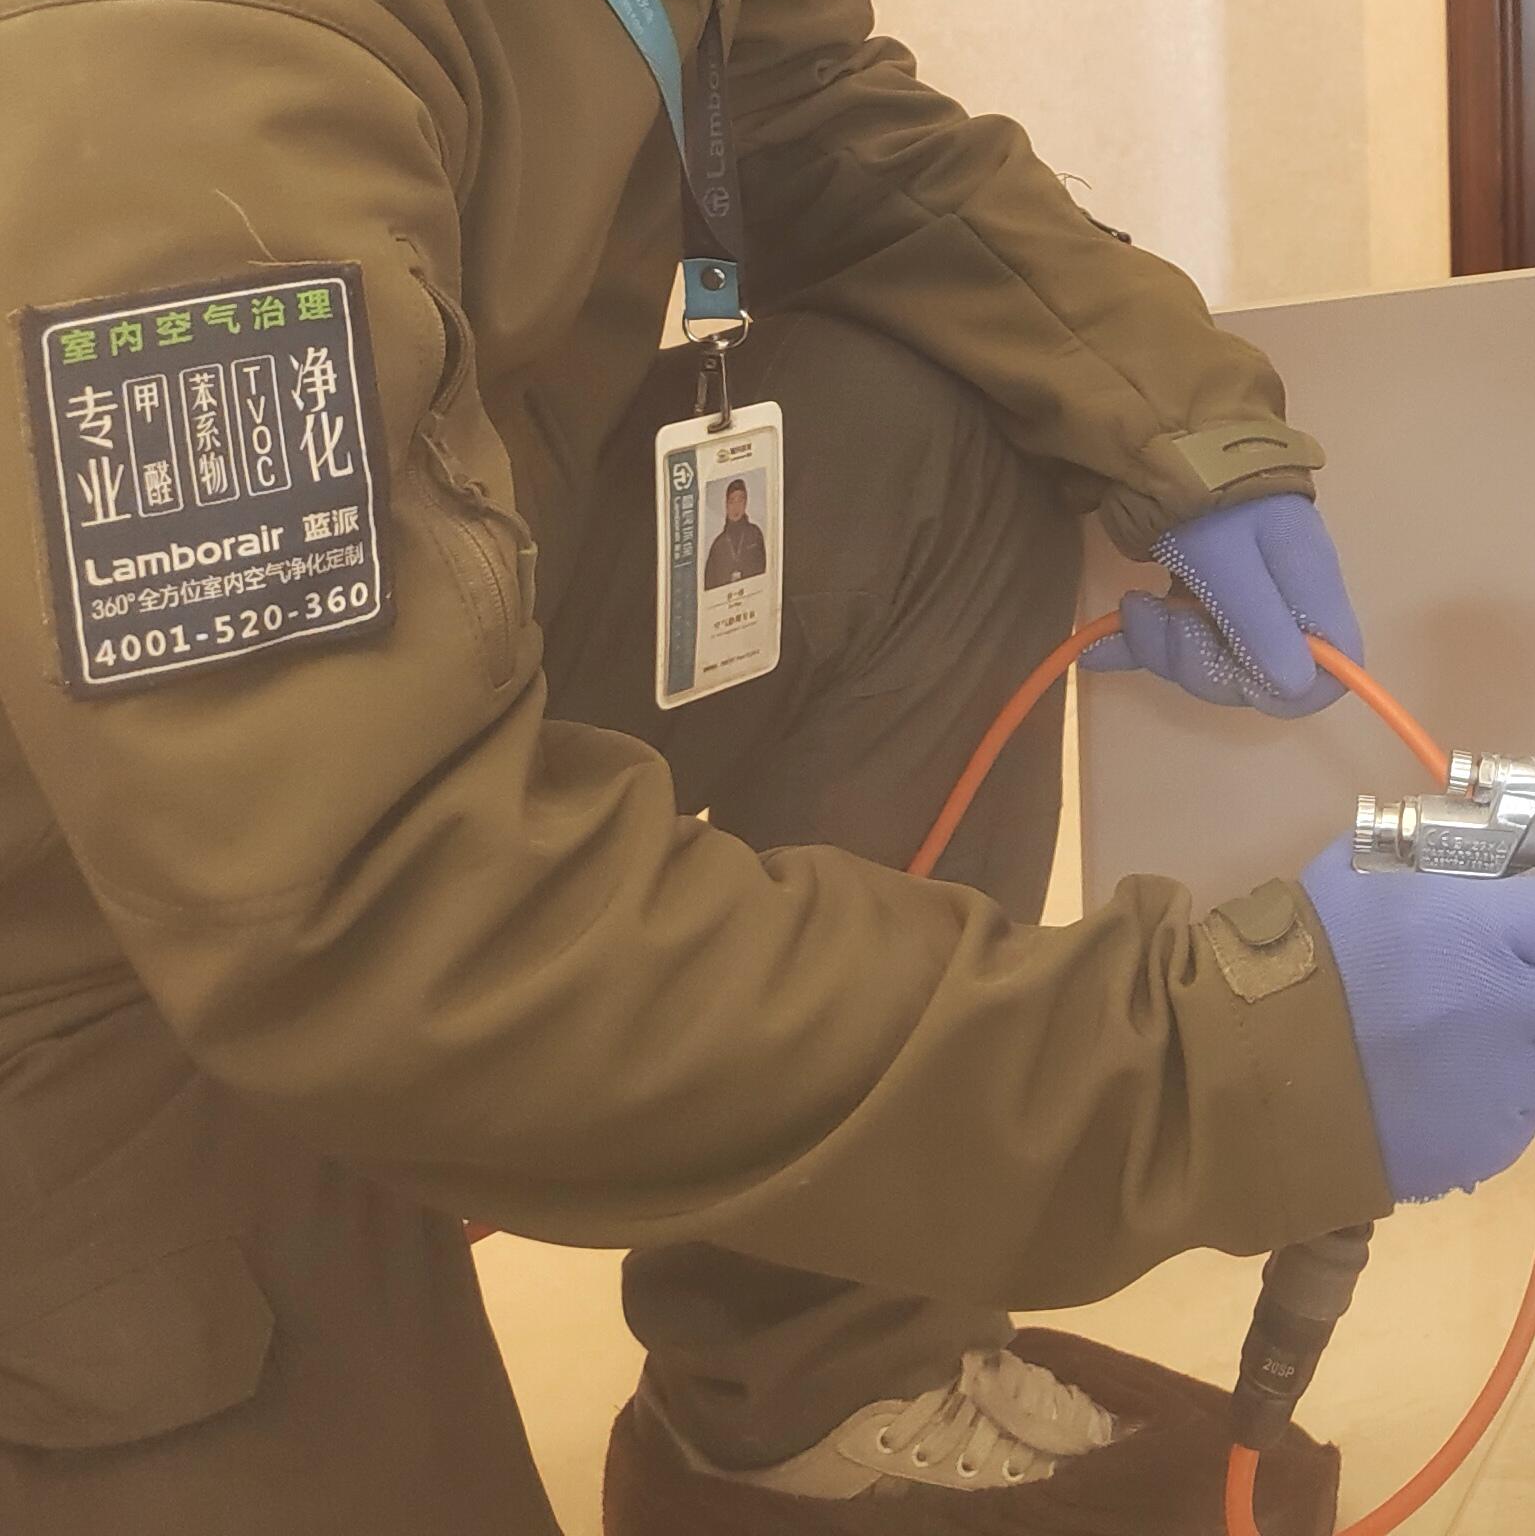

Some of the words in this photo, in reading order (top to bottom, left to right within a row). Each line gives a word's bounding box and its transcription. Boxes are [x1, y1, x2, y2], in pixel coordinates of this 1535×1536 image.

[60, 288, 333, 365] 室内空气治理
[66, 386, 131, 527] 专业
[134, 382, 174, 506] 甲醛
[189, 372, 228, 495] 苯系物
[243, 366, 275, 486] TVOC
[290, 346, 354, 483] 净化
[85, 525, 284, 586] Lamborair
[303, 506, 358, 542] 蓝派
[95, 582, 368, 666] 4001-520-360
